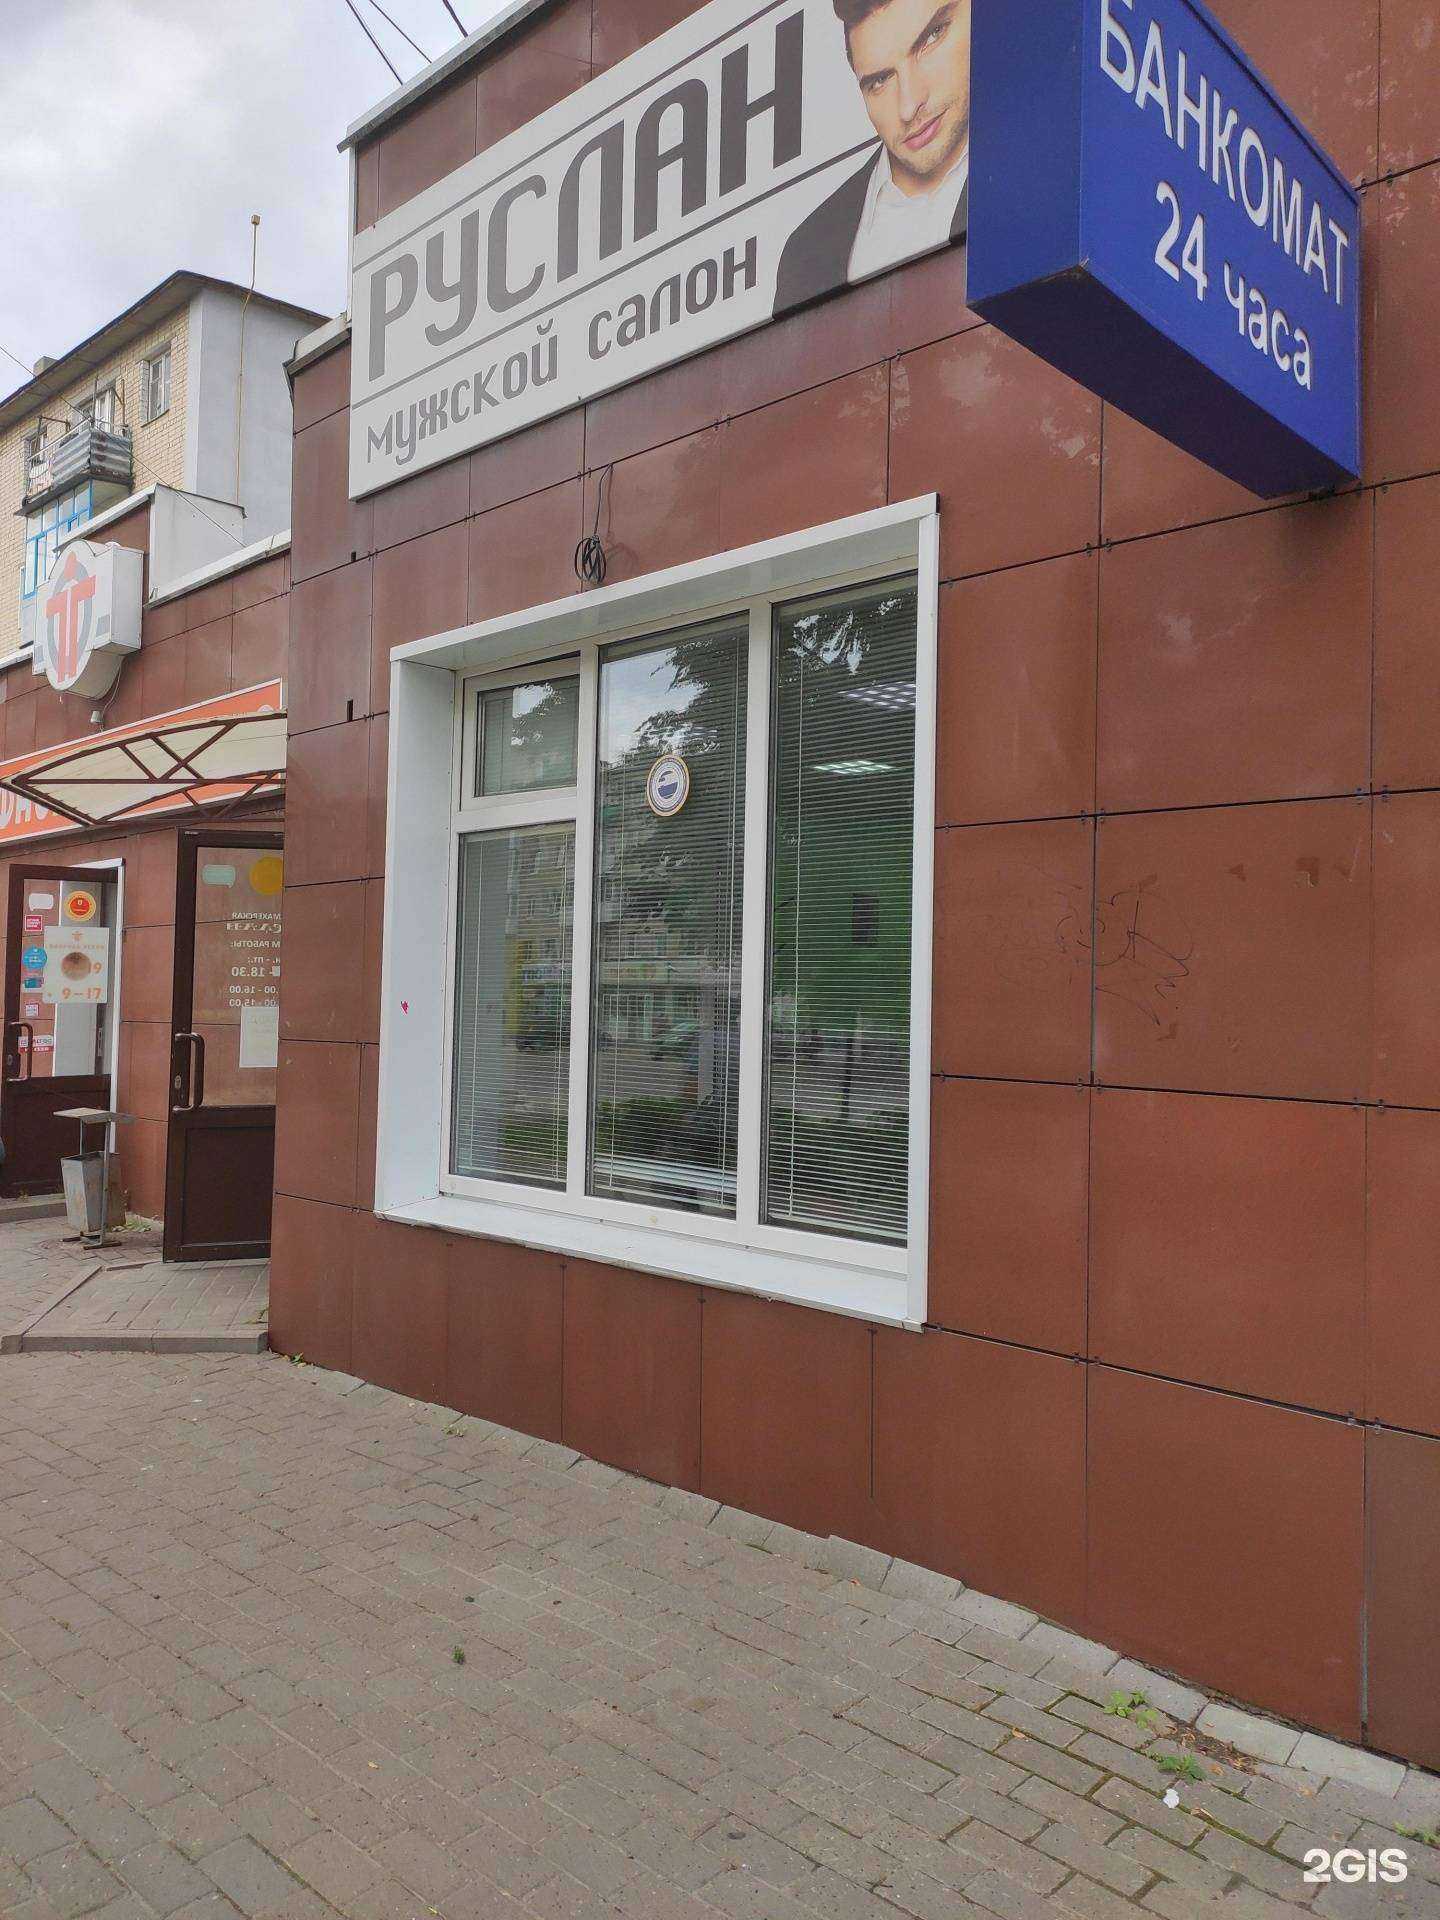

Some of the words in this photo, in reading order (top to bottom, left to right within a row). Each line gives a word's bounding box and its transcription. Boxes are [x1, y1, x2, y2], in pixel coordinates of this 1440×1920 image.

[369, 9, 804, 383] РУСЛАН
[1100, 0, 1349, 305] БАНКОМАТ
[588, 235, 757, 362] салон
[1155, 181, 1208, 301] 24
[1223, 261, 1312, 391] часа
